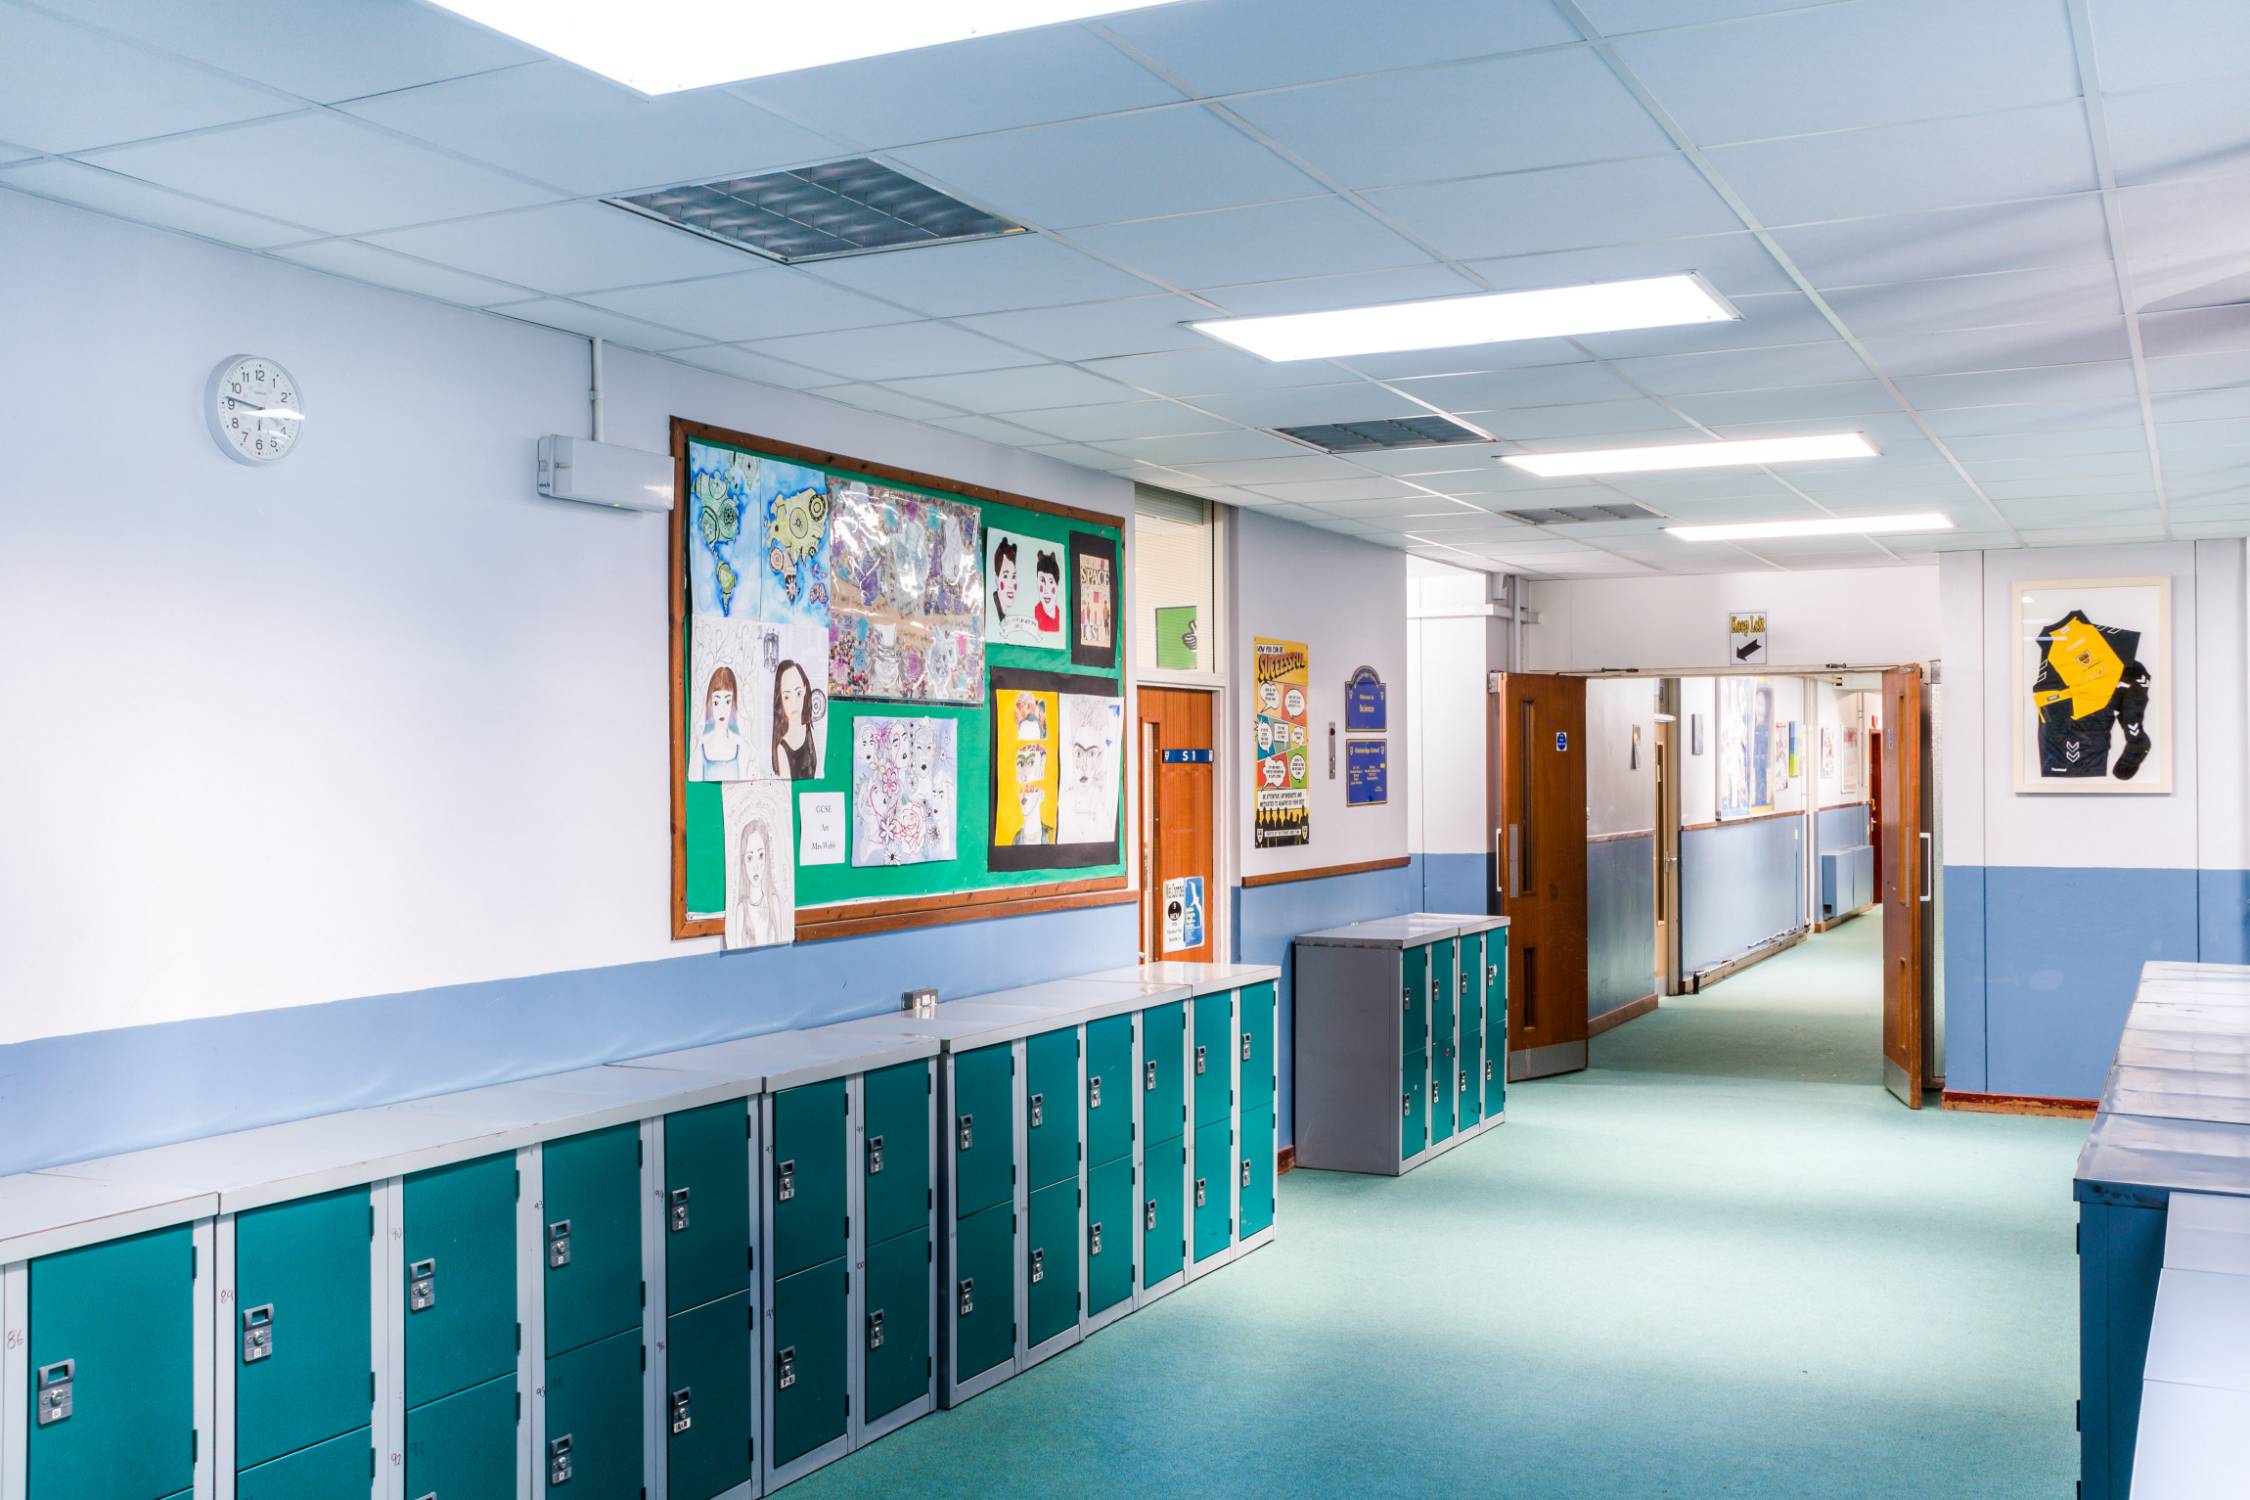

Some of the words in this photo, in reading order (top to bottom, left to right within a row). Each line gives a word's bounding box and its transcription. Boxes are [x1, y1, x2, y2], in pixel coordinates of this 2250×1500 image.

[242, 372, 250, 383] 11
[255, 370, 265, 382] 12
[231, 382, 242, 394] 10
[272, 378, 276, 389] 1
[280, 392, 288, 403] 2
[227, 399, 235, 410] 9
[231, 417, 239, 429] 8
[241, 432, 249, 442] 7
[280, 427, 287, 436] 4
[255, 439, 263, 450] 6
[270, 437, 278, 448] 5
[1080, 565, 1110, 586] SPACE
[1258, 652, 1305, 683] SUCCESSFUL
[816, 805, 832, 813] GCSE
[7, 1329, 25, 1350] 86
